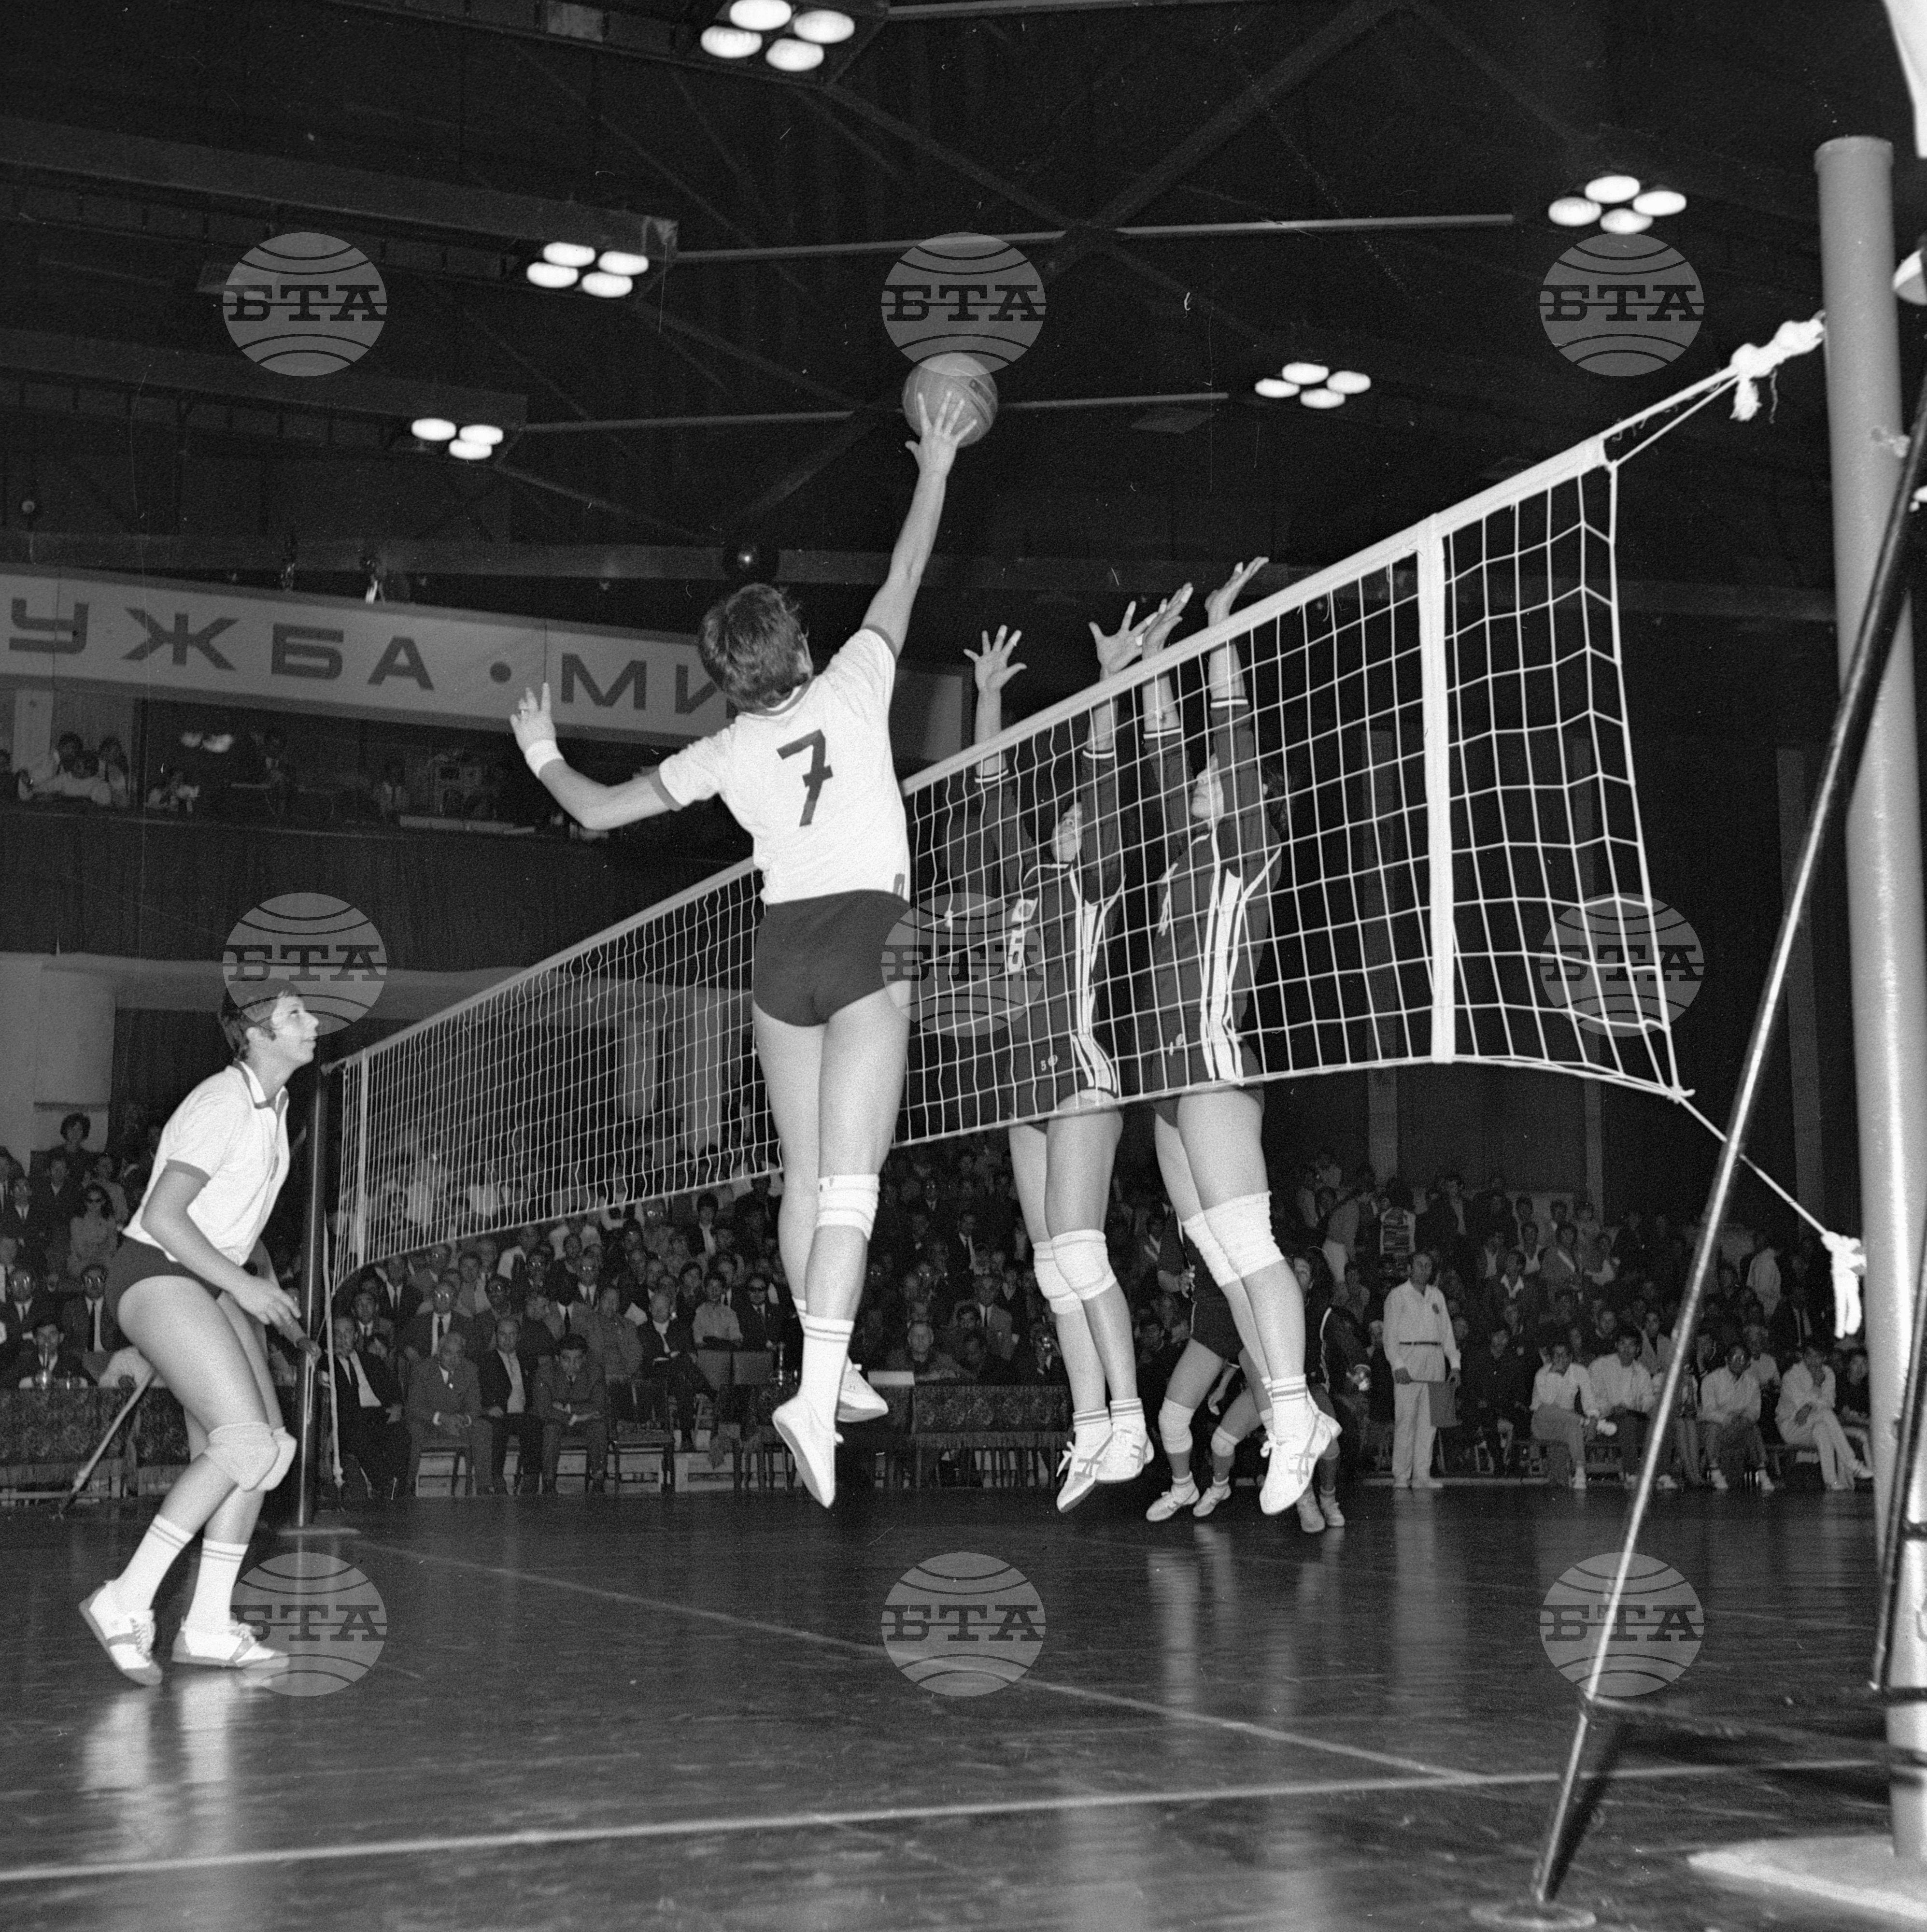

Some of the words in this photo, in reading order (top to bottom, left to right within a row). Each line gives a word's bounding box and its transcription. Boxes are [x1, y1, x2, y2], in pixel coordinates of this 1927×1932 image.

[8, 597, 434, 691] УЖБА
[776, 728, 834, 827] 7
[1041, 1060, 1047, 1071] 5
